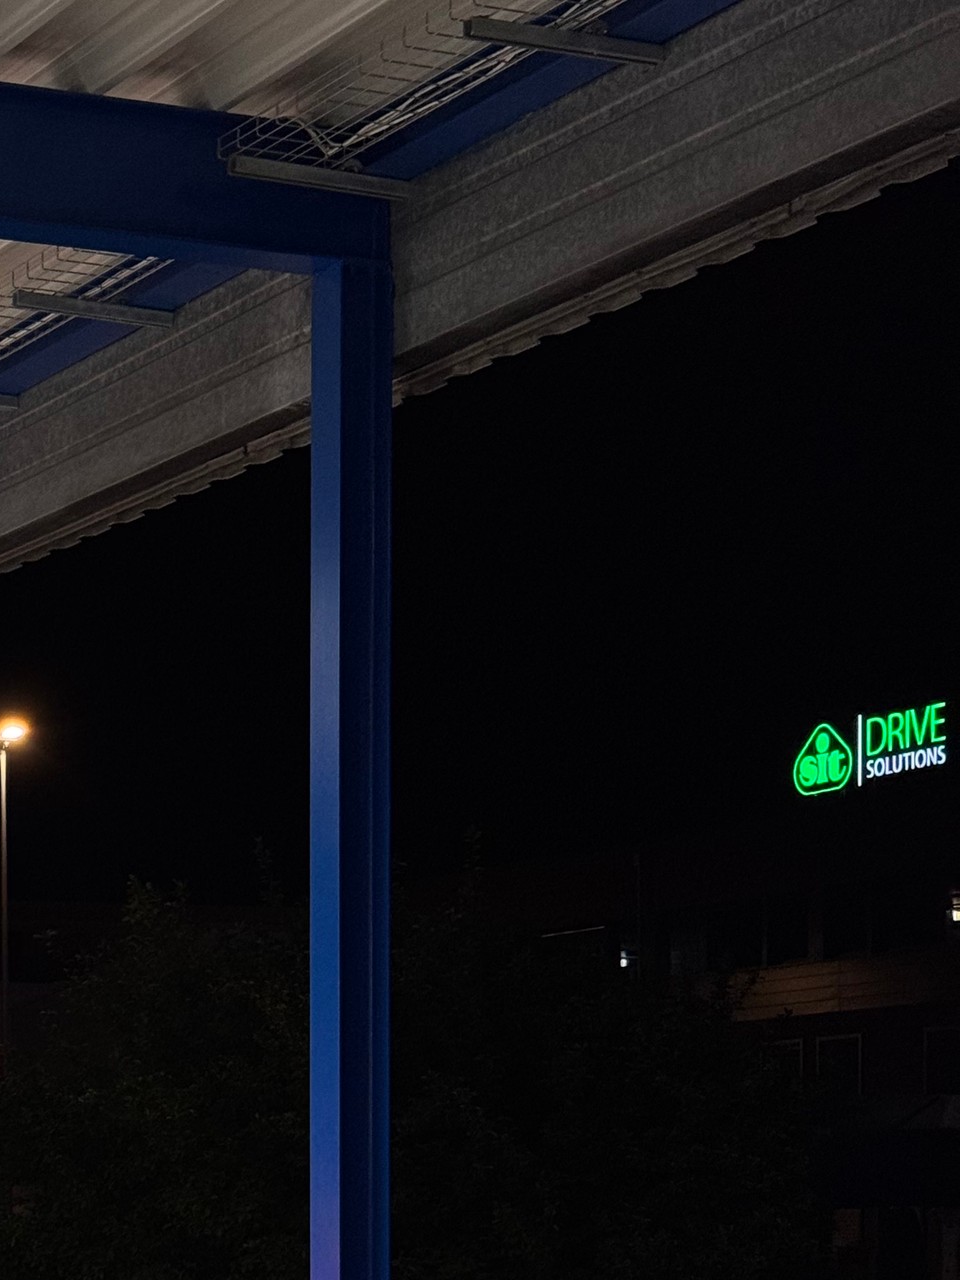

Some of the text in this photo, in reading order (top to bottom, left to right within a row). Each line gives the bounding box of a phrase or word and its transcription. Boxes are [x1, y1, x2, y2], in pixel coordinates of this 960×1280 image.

[866, 702, 946, 757] DRIVE
[799, 732, 847, 787] sit
[866, 745, 947, 779] SOLUTIONS
